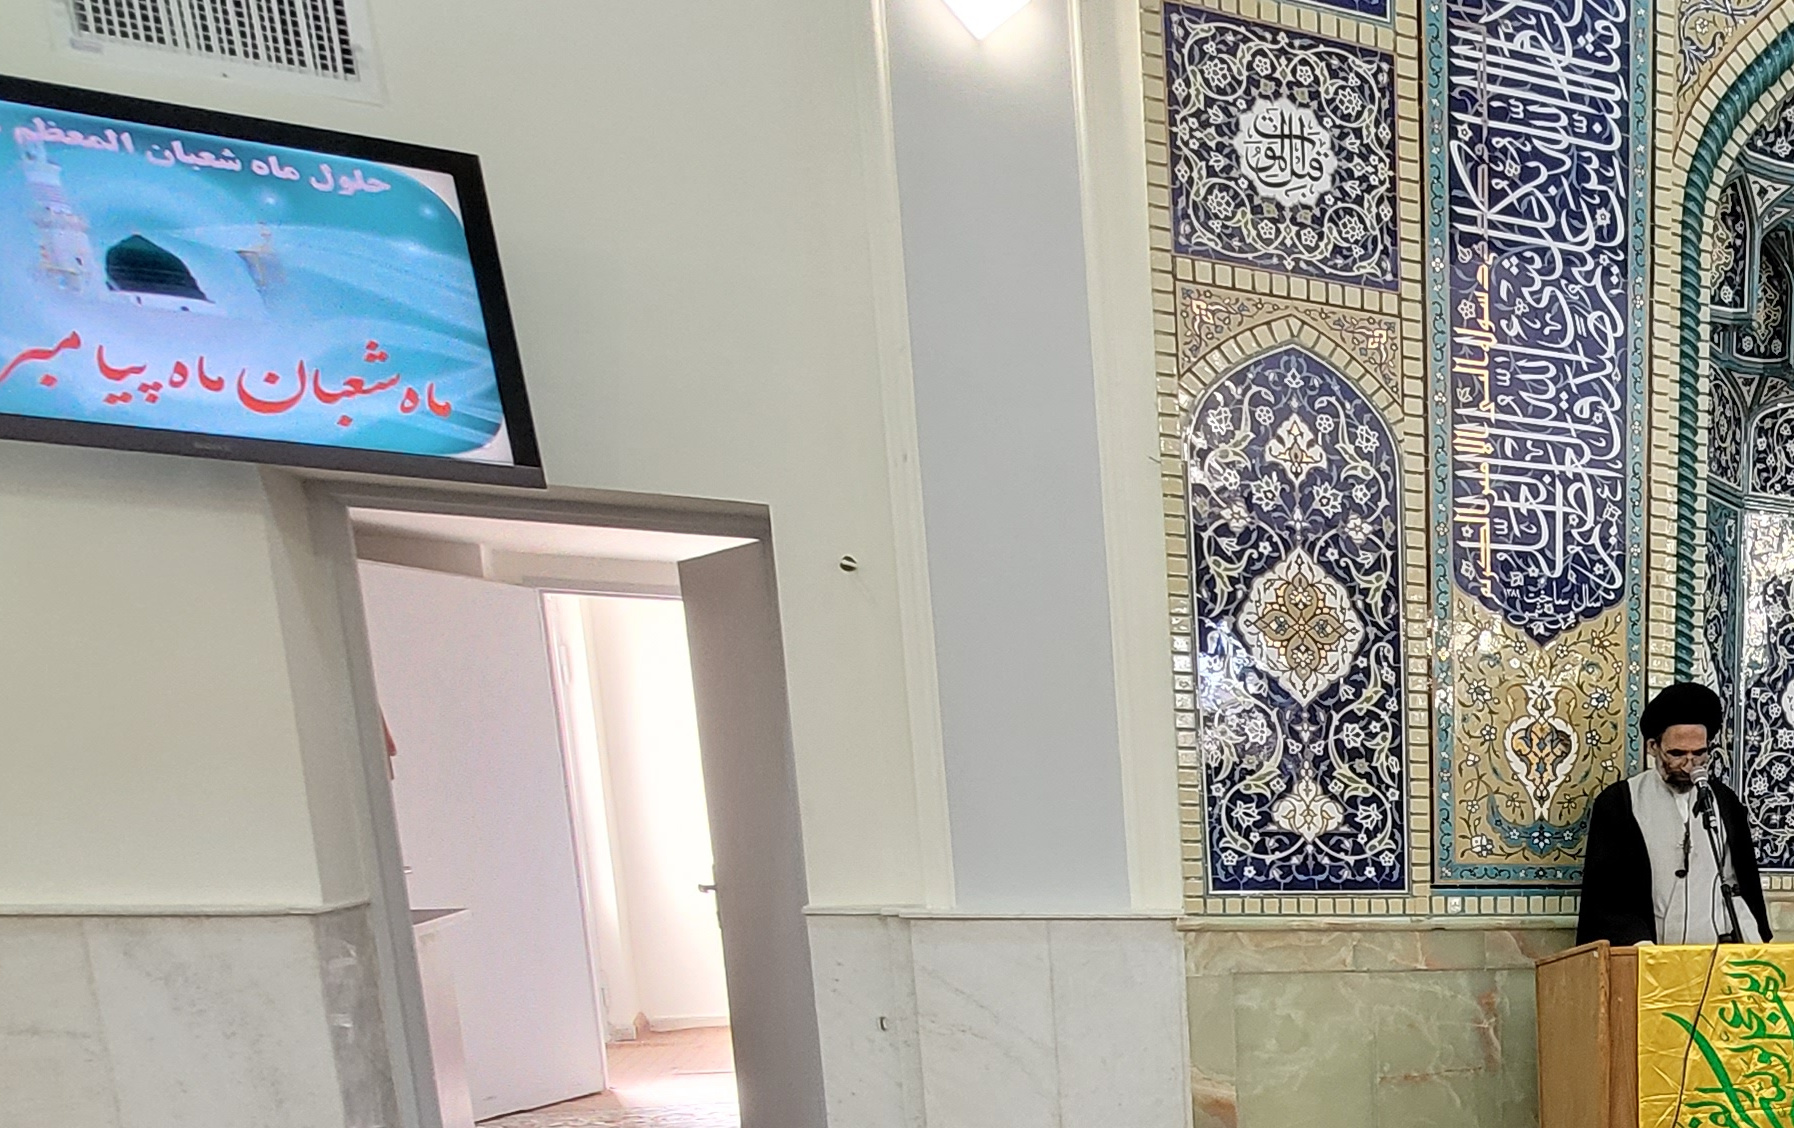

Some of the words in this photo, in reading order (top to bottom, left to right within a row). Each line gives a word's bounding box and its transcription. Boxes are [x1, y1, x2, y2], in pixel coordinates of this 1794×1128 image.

[13, 116, 133, 154] المعظم
[145, 140, 243, 172] شعبان
[251, 154, 301, 182] ماه
[309, 163, 391, 197] حلول
[168, 356, 226, 391] ماه
[236, 340, 401, 428] شعبان
[399, 382, 452, 418] ماه
[1523, 580, 1571, 605] ساخت
[1572, 583, 1602, 612] سال
